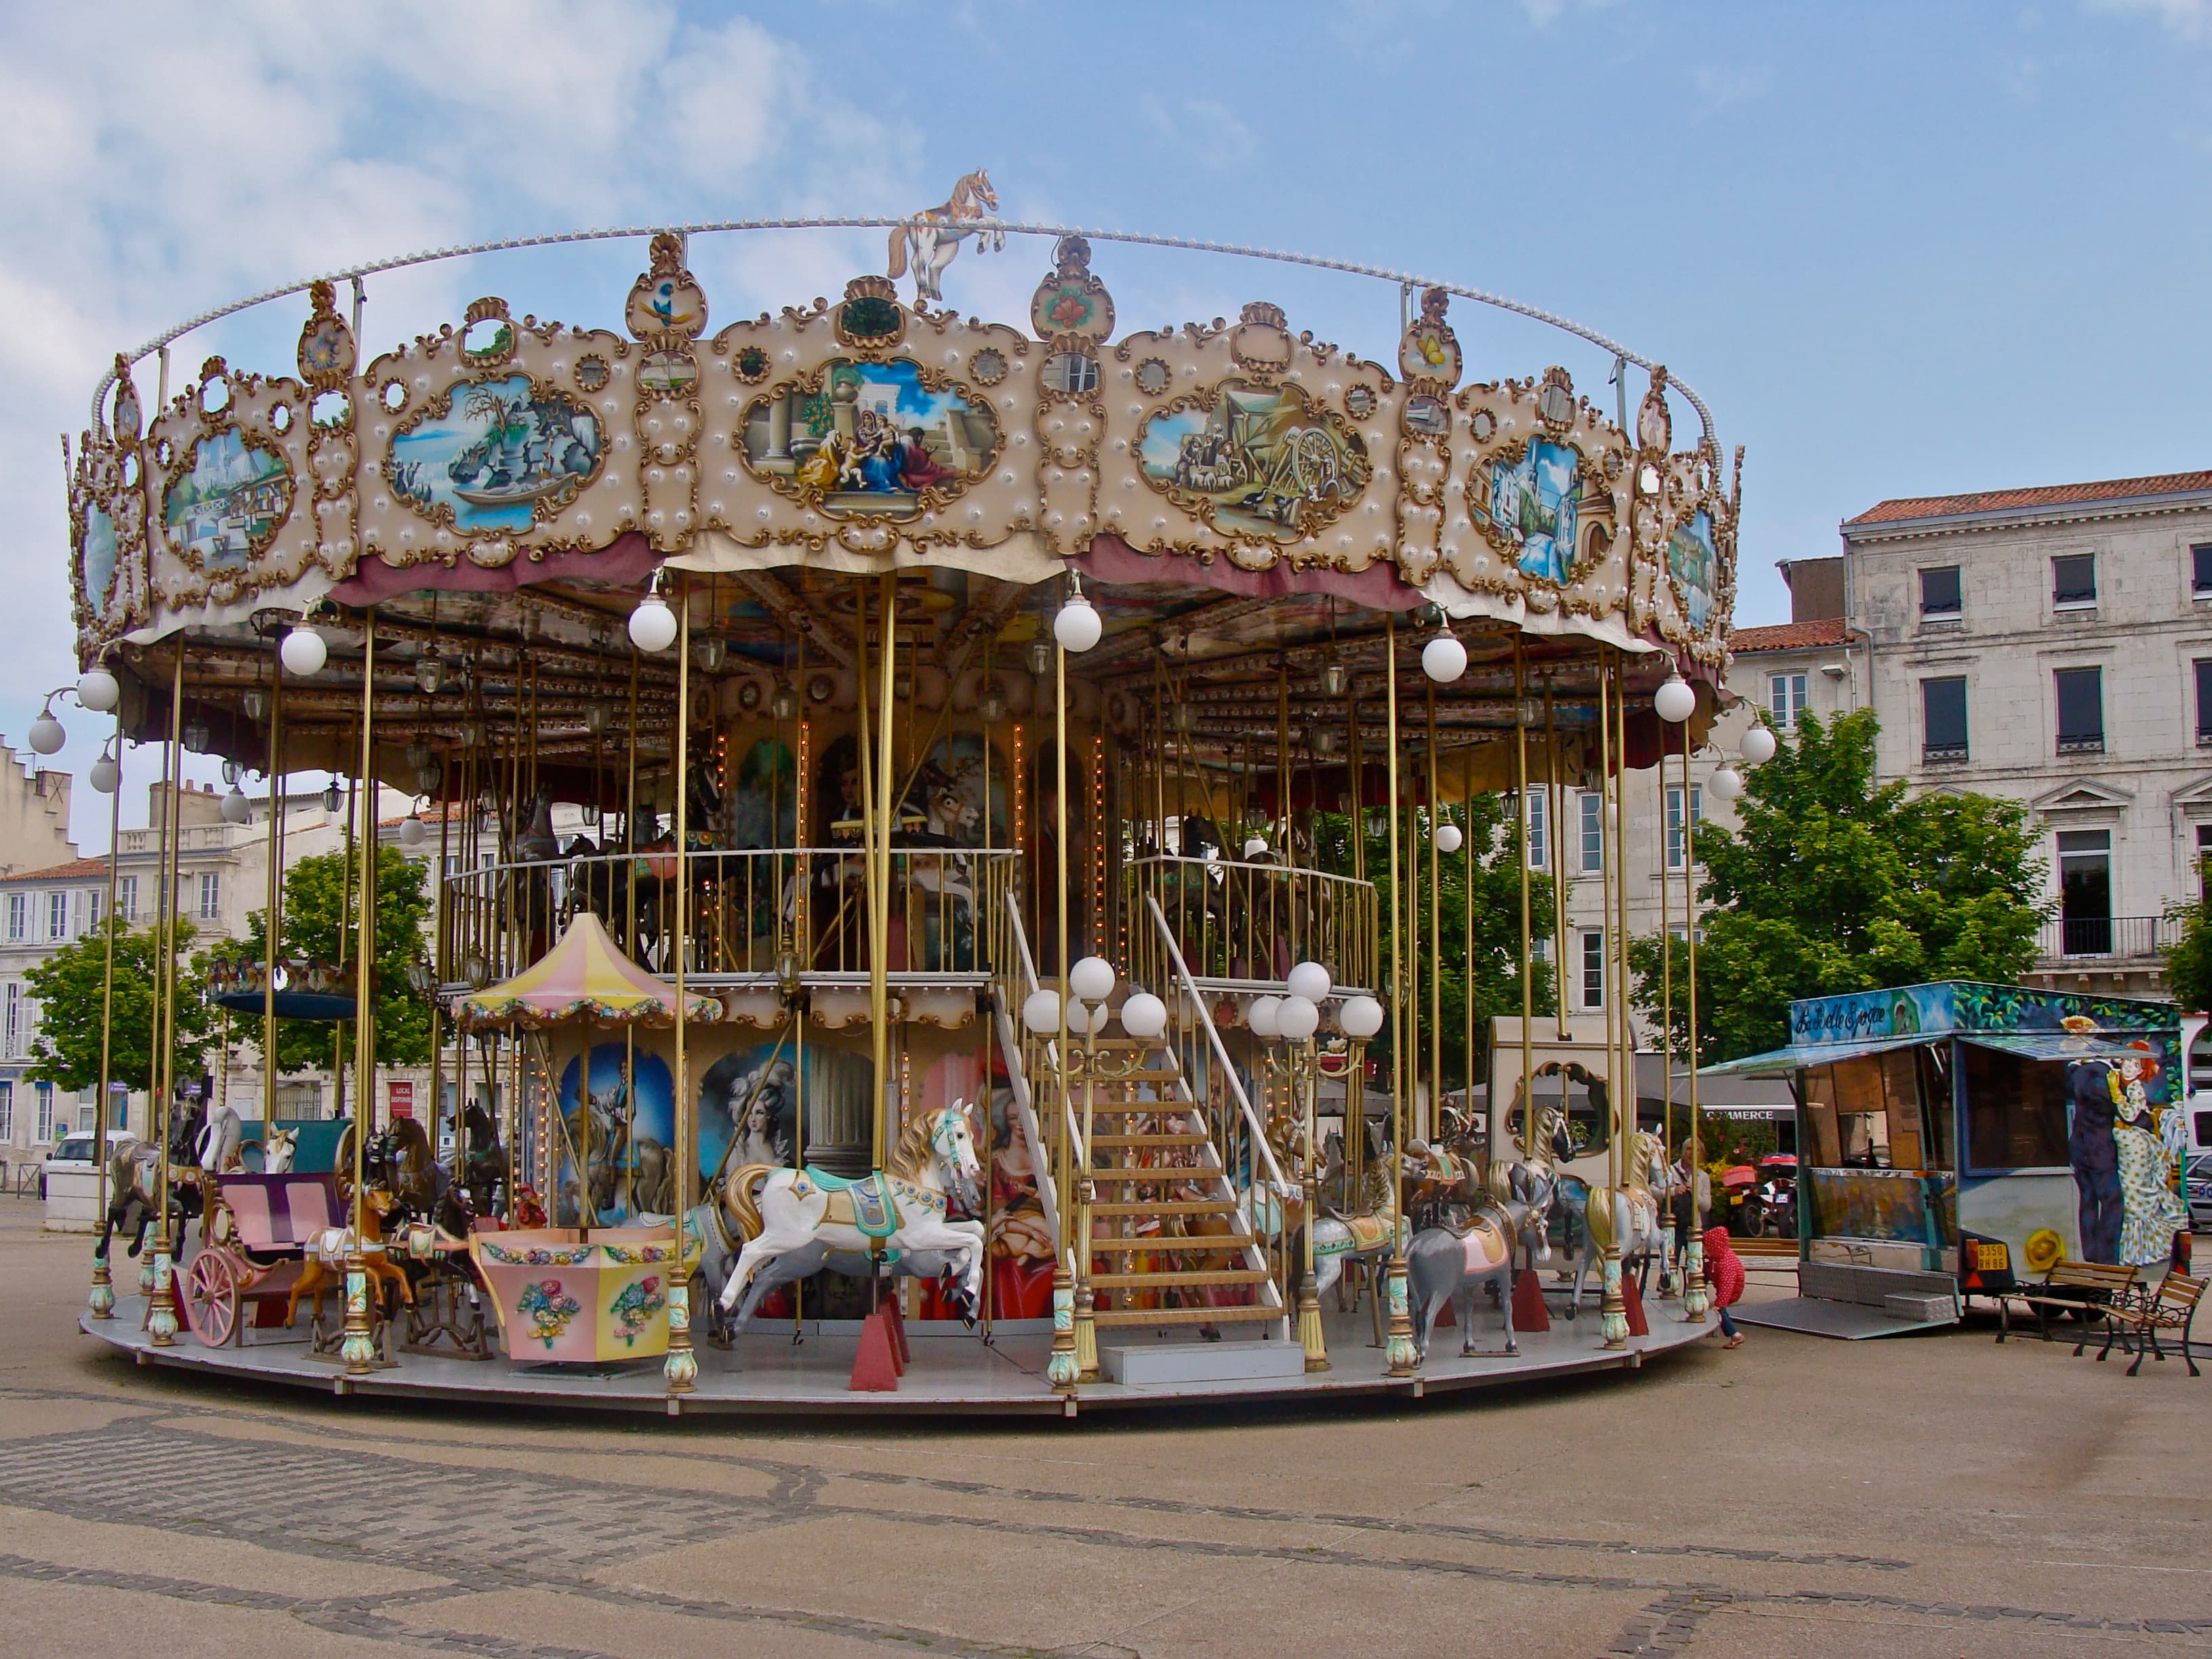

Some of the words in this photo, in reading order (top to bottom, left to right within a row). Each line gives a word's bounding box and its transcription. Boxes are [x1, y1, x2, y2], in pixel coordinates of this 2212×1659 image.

[1796, 1006, 1811, 1034] La
[1812, 1002, 1843, 1030] Belle
[1706, 1111, 1773, 1120] CMMERCE
[1979, 1246, 2003, 1256] 6350
